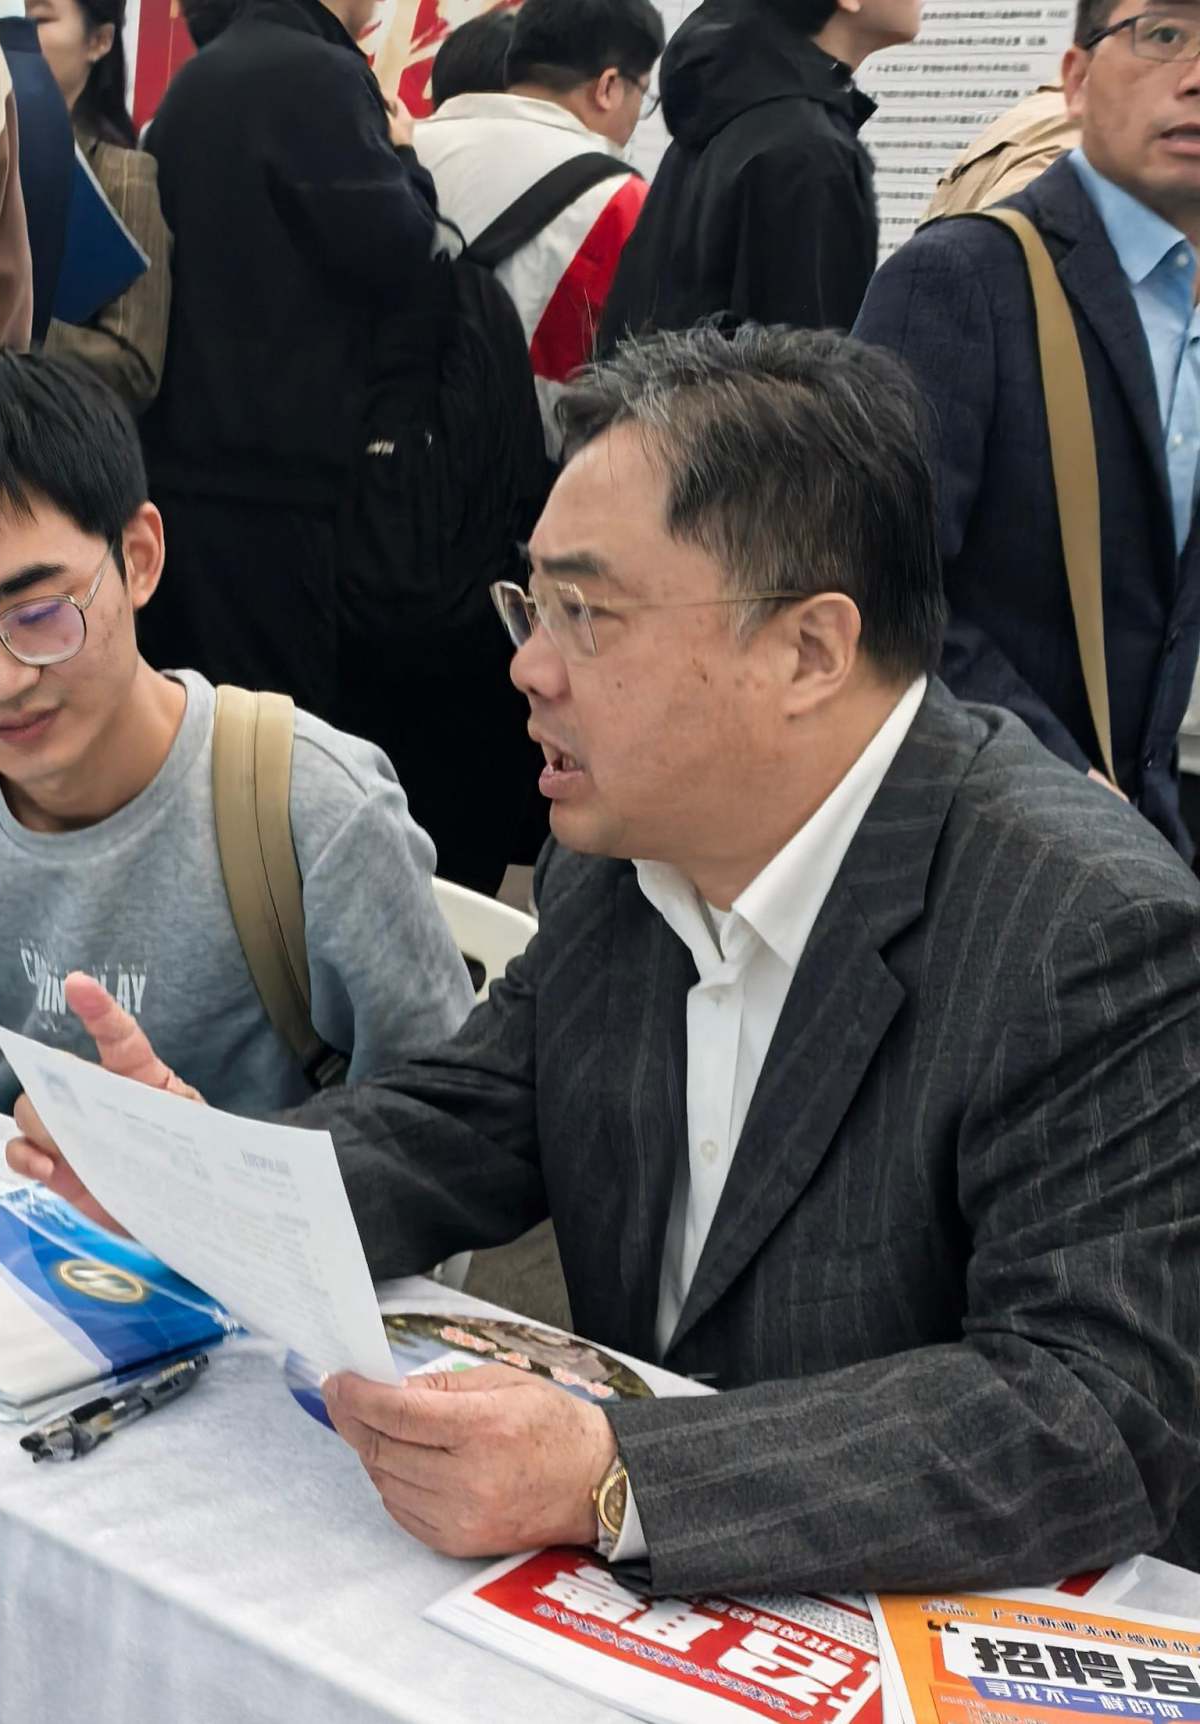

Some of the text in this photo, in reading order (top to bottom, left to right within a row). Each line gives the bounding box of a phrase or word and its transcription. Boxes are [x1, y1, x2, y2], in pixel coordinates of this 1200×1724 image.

[971, 1637, 1200, 1698] 招聘启
[985, 1681, 1184, 1718] 寻找不一样的你
